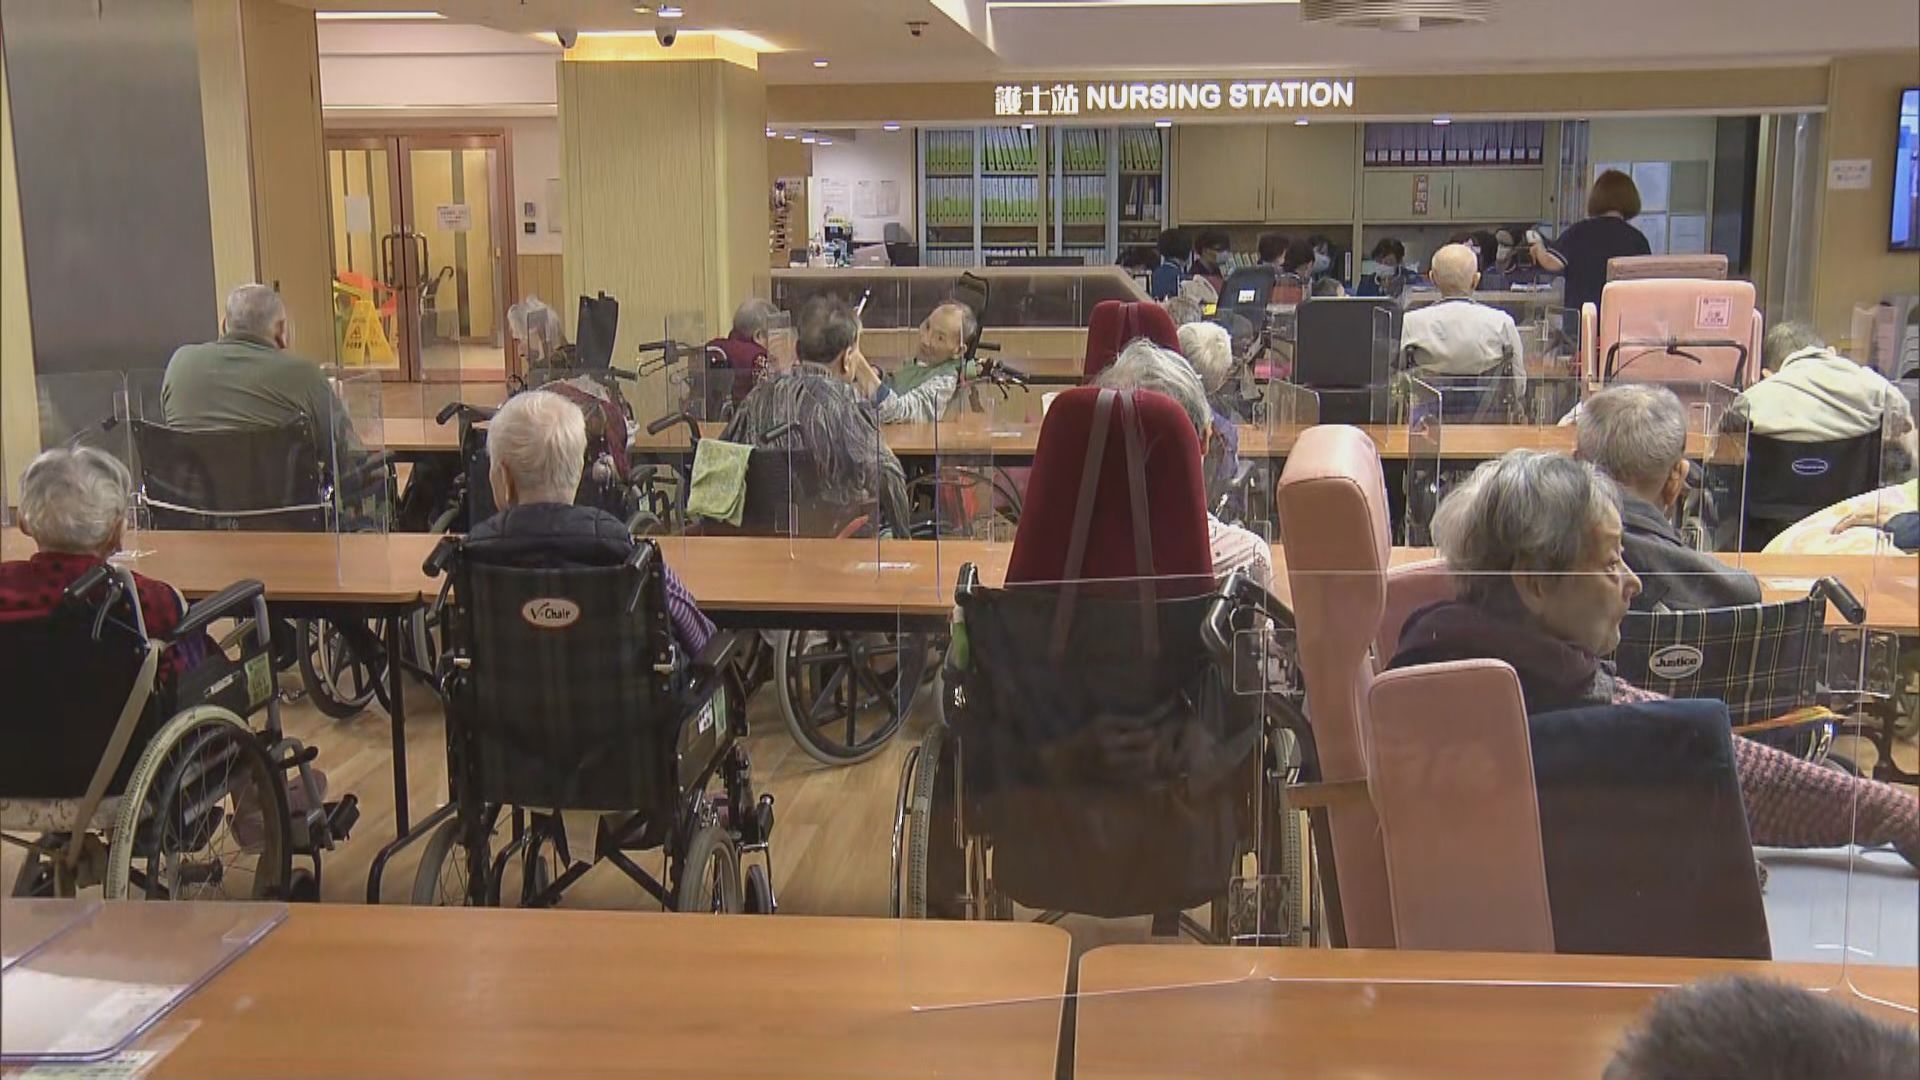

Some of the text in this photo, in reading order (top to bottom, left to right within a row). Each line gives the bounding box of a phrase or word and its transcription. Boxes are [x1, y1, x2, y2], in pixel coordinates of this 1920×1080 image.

[994, 85, 1080, 116] 護士站
[1086, 82, 1354, 110] NURSING STATION
[1655, 656, 1698, 667] Justice
